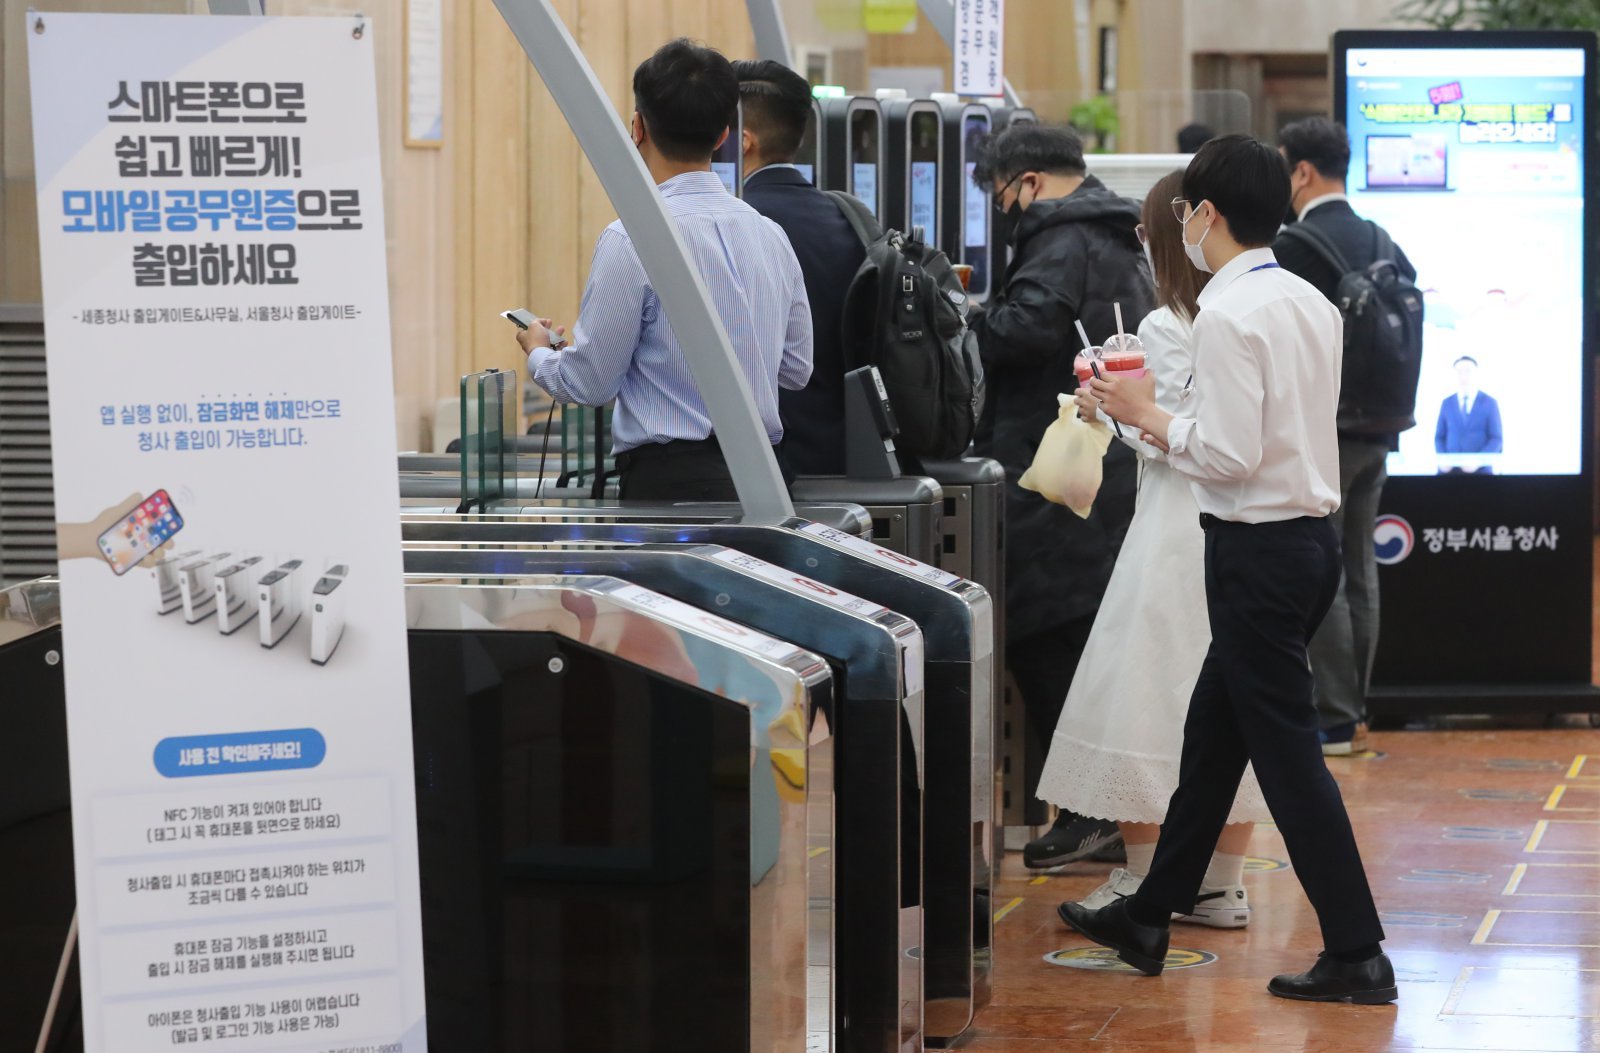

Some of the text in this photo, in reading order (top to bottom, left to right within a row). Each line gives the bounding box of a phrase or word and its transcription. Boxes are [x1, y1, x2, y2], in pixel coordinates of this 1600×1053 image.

[108, 81, 307, 123] 스마트폰으로
[115, 136, 301, 178] 쉽고 빠르게!
[133, 243, 299, 287] 출입하세요
[81, 308, 130, 324] 세종청사
[134, 306, 243, 324] 출입게이트&사무실,
[246, 306, 293, 322] 서울청사
[100, 399, 341, 425] 앱 실행 없이, 잠금화면 해제만으로
[138, 428, 307, 451] 청사 출입이 가능합니다.
[1422, 526, 1559, 553] 정부서울청사
[179, 741, 300, 766] 사용 전 확인해주세요!
[164, 798, 321, 822] NFC 기능이 켜져 있어야 합니다
[181, 826, 190, 840] 시
[195, 825, 205, 839] 꼭
[210, 821, 253, 837] 휴대폰을
[304, 814, 340, 830] 하세요)
[128, 859, 365, 893] 청사출입 시 휴대폰마다 접촉시켜야 하는 위치가
[188, 882, 308, 906] 조금씩 다를 수 있습니다
[174, 929, 327, 956] 휴대폰 잠금 기능을 설정하시고
[148, 945, 354, 978] 출입 시 잠금 해제를 실행해 주시면 됩니다
[148, 993, 360, 1027] 아이폰은 청사출입 기능 사용이 어렵습니다
[172, 1013, 339, 1044] (발급 및 로그인 기능 사용은 가능)
